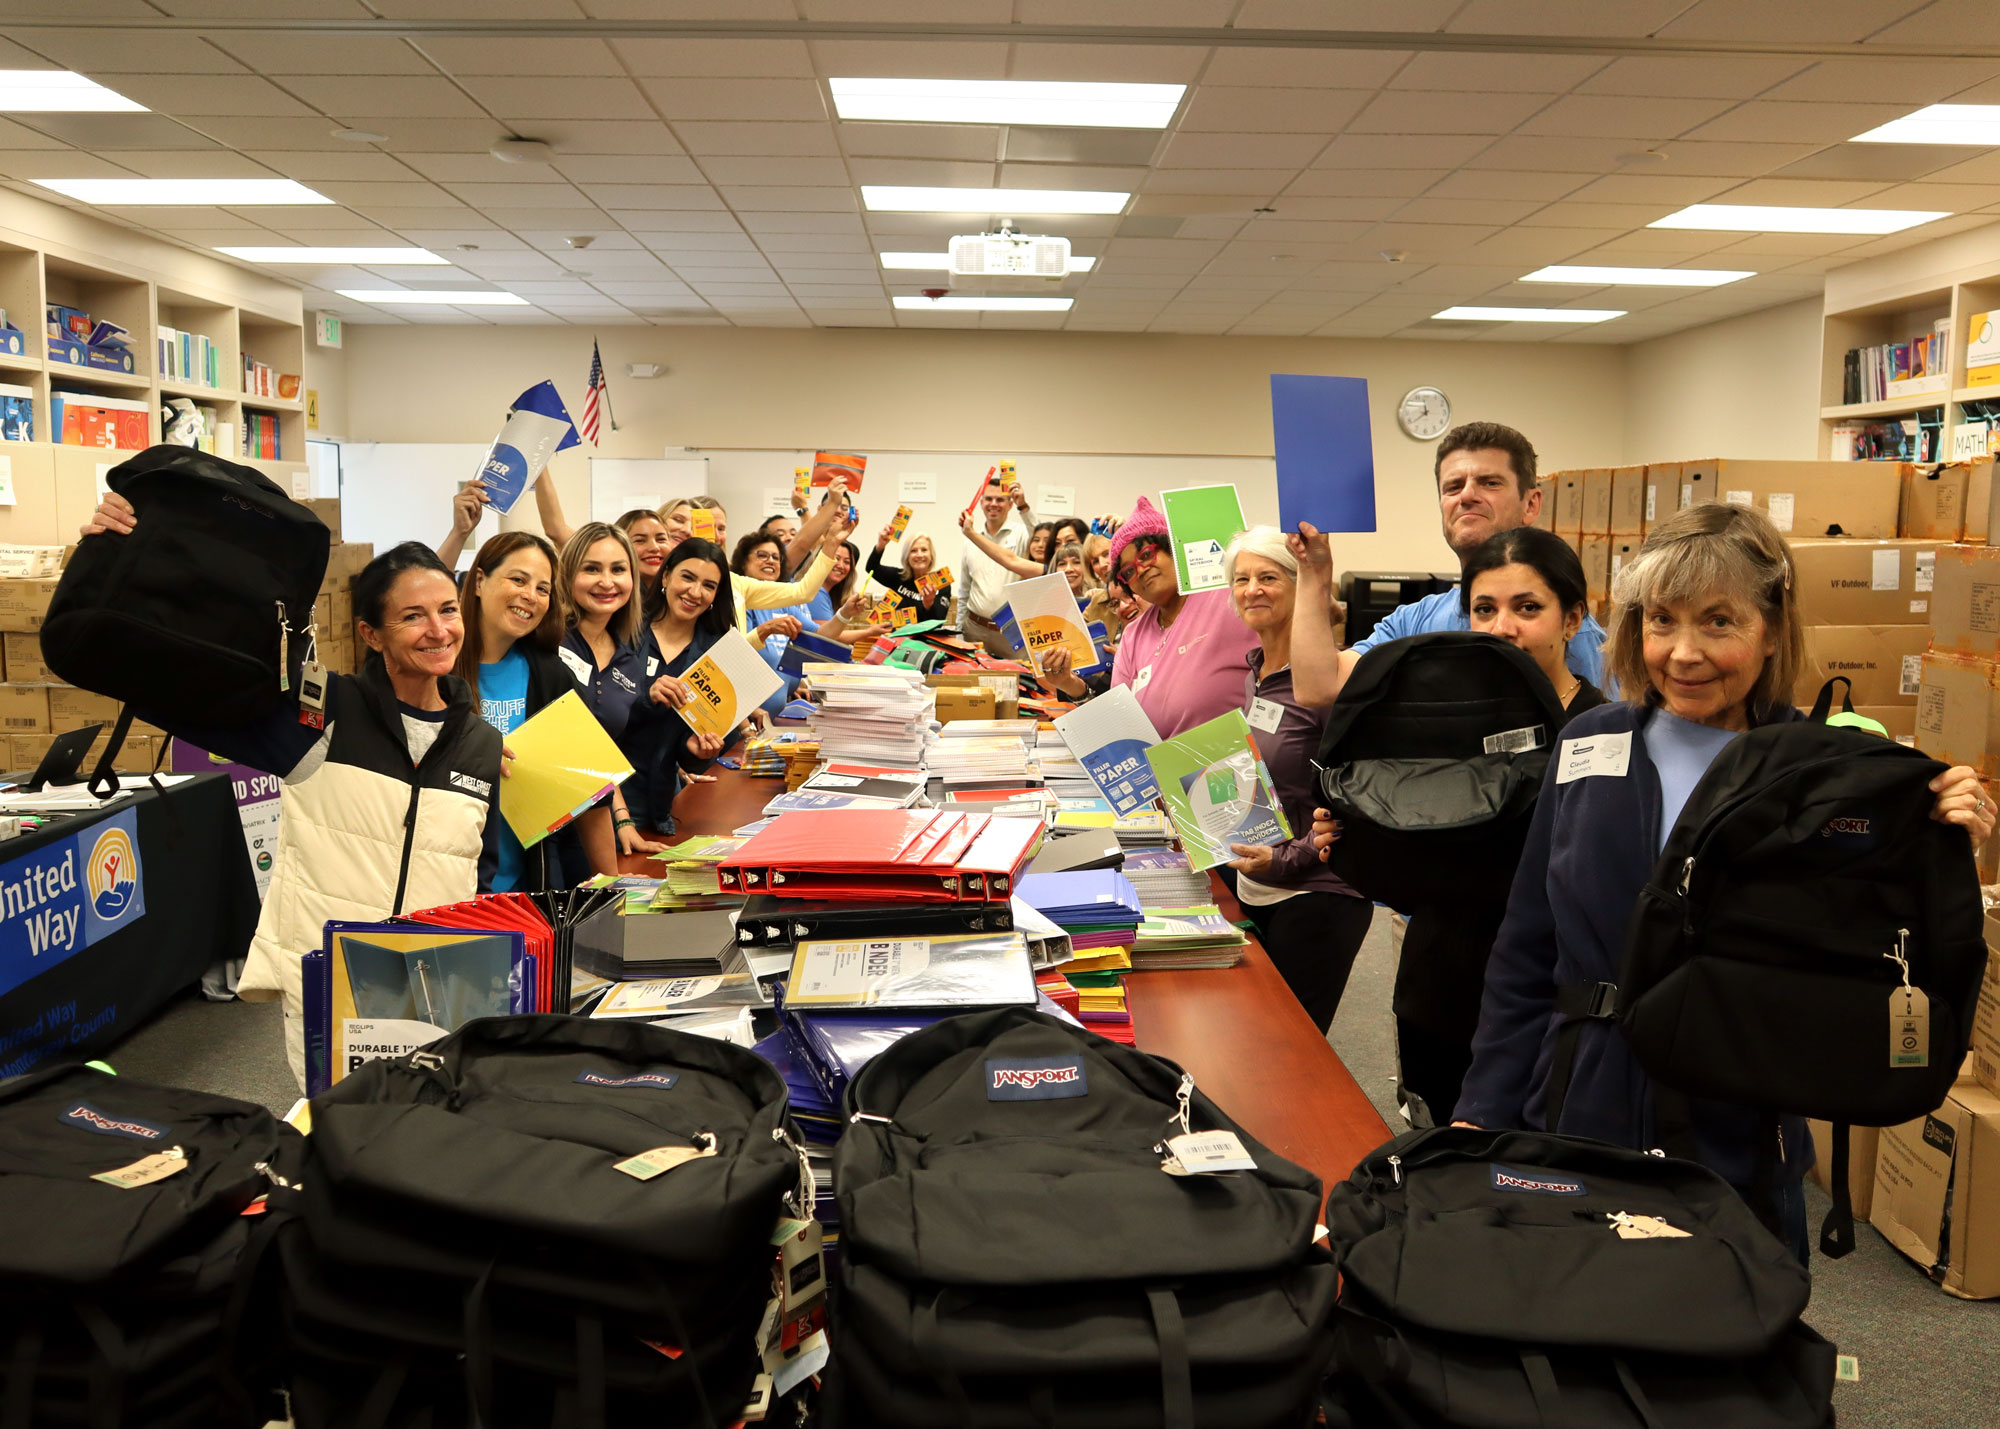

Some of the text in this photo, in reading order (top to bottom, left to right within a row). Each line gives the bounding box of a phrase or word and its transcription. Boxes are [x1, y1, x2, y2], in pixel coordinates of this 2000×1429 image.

[308, 400, 317, 423] 4
[105, 422, 116, 449] 5
[1955, 433, 1986, 454] MATH
[1831, 578, 1870, 589] VF Outdoor,
[1027, 629, 1041, 637] FILLER
[1029, 630, 1063, 647] PAPER
[697, 667, 710, 681] FILLER
[1828, 661, 1878, 671] VF Outdoor, Inc.
[690, 671, 721, 706] PAPER
[480, 698, 525, 717] STUFF
[1093, 762, 1111, 774] FILLER
[1097, 757, 1139, 785] PAPER
[1241, 818, 1276, 838] TAB INDEX
[1247, 825, 1279, 844] DIVIDERS
[25, 904, 80, 957] Way
[867, 942, 889, 977] BNDER
[665, 979, 693, 998] BNDER
[46, 1000, 77, 1032] Way
[71, 1003, 116, 1044] County
[349, 1044, 399, 1053] DURABLE
[585, 1074, 671, 1085] JANSPORT
[993, 1065, 1080, 1088] JANSPORT
[68, 1106, 160, 1139] JANSPORT
[1496, 1173, 1580, 1193] JANSPORT
